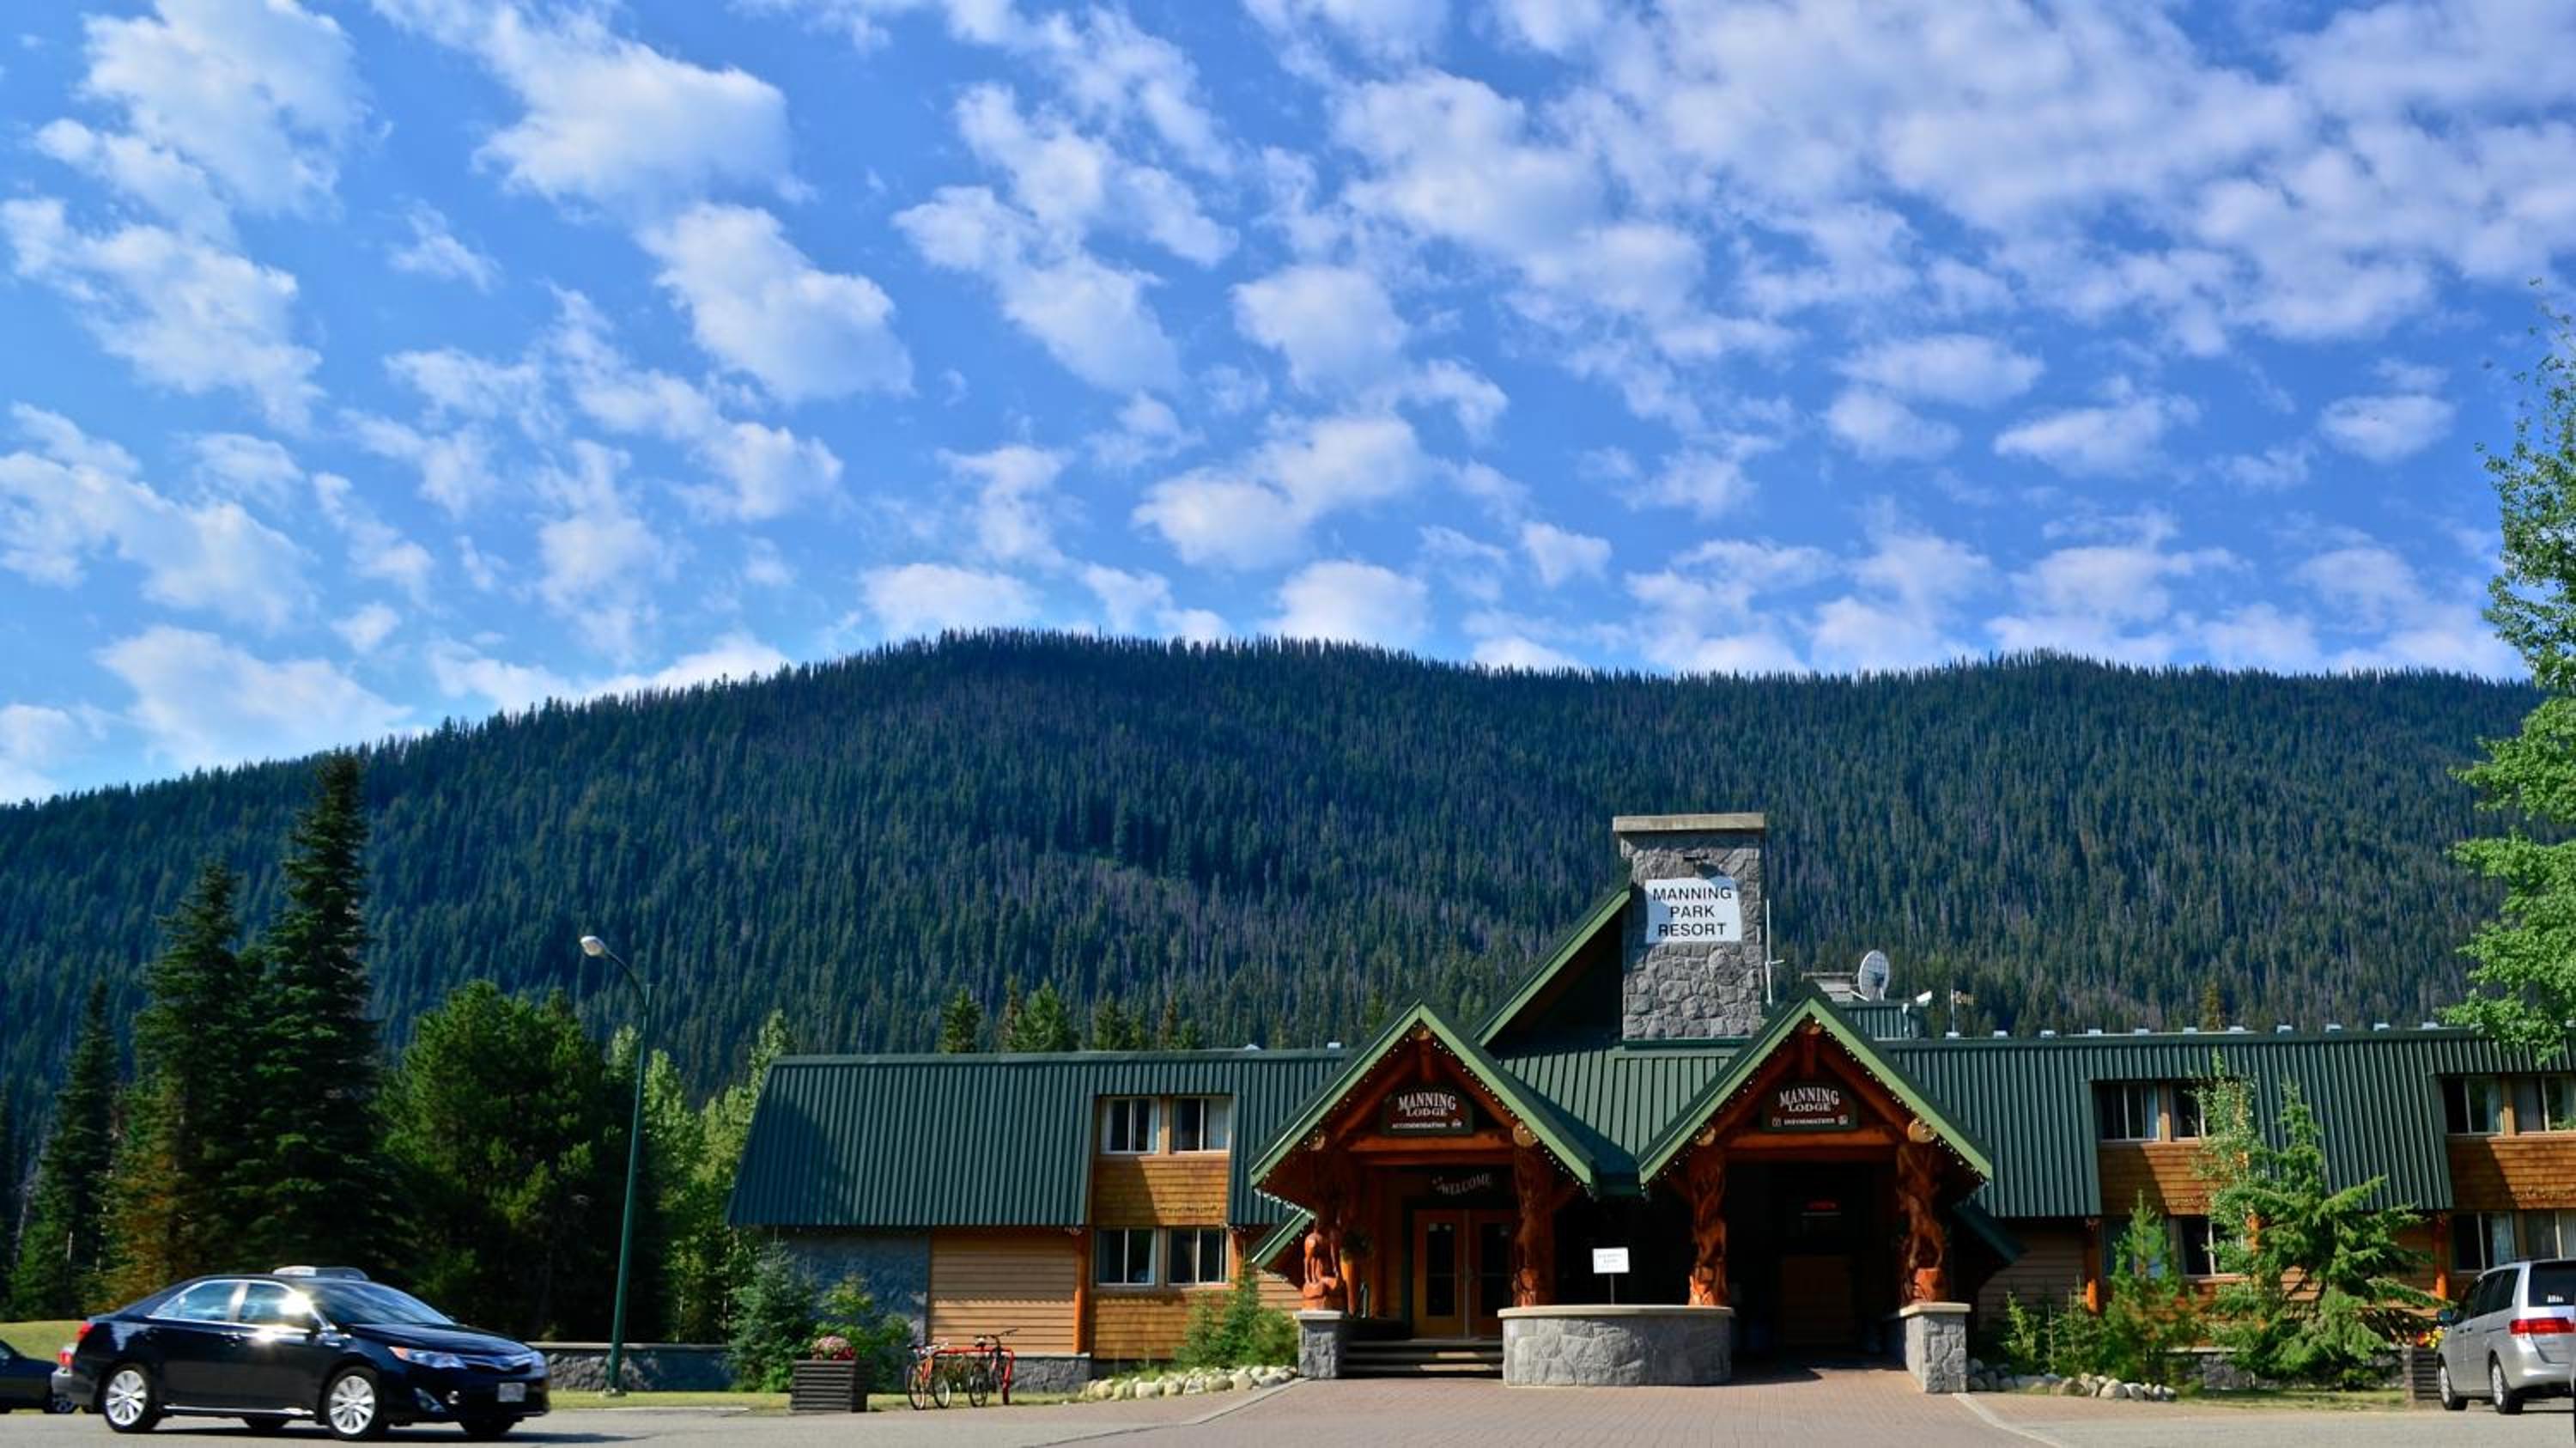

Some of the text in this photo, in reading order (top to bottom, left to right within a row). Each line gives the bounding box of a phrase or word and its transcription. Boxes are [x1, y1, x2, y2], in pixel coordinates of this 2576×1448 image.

[1653, 887, 1732, 901] MANNING
[1670, 905, 1716, 918] PARK
[1658, 922, 1726, 936] RESORT
[1398, 1092, 1457, 1111] MANNING
[1779, 1086, 1840, 1108] MANNING
[1406, 1107, 1448, 1116] LODGE
[1788, 1103, 1831, 1112] LODGE
[1441, 1172, 1492, 1196] WELCOME
